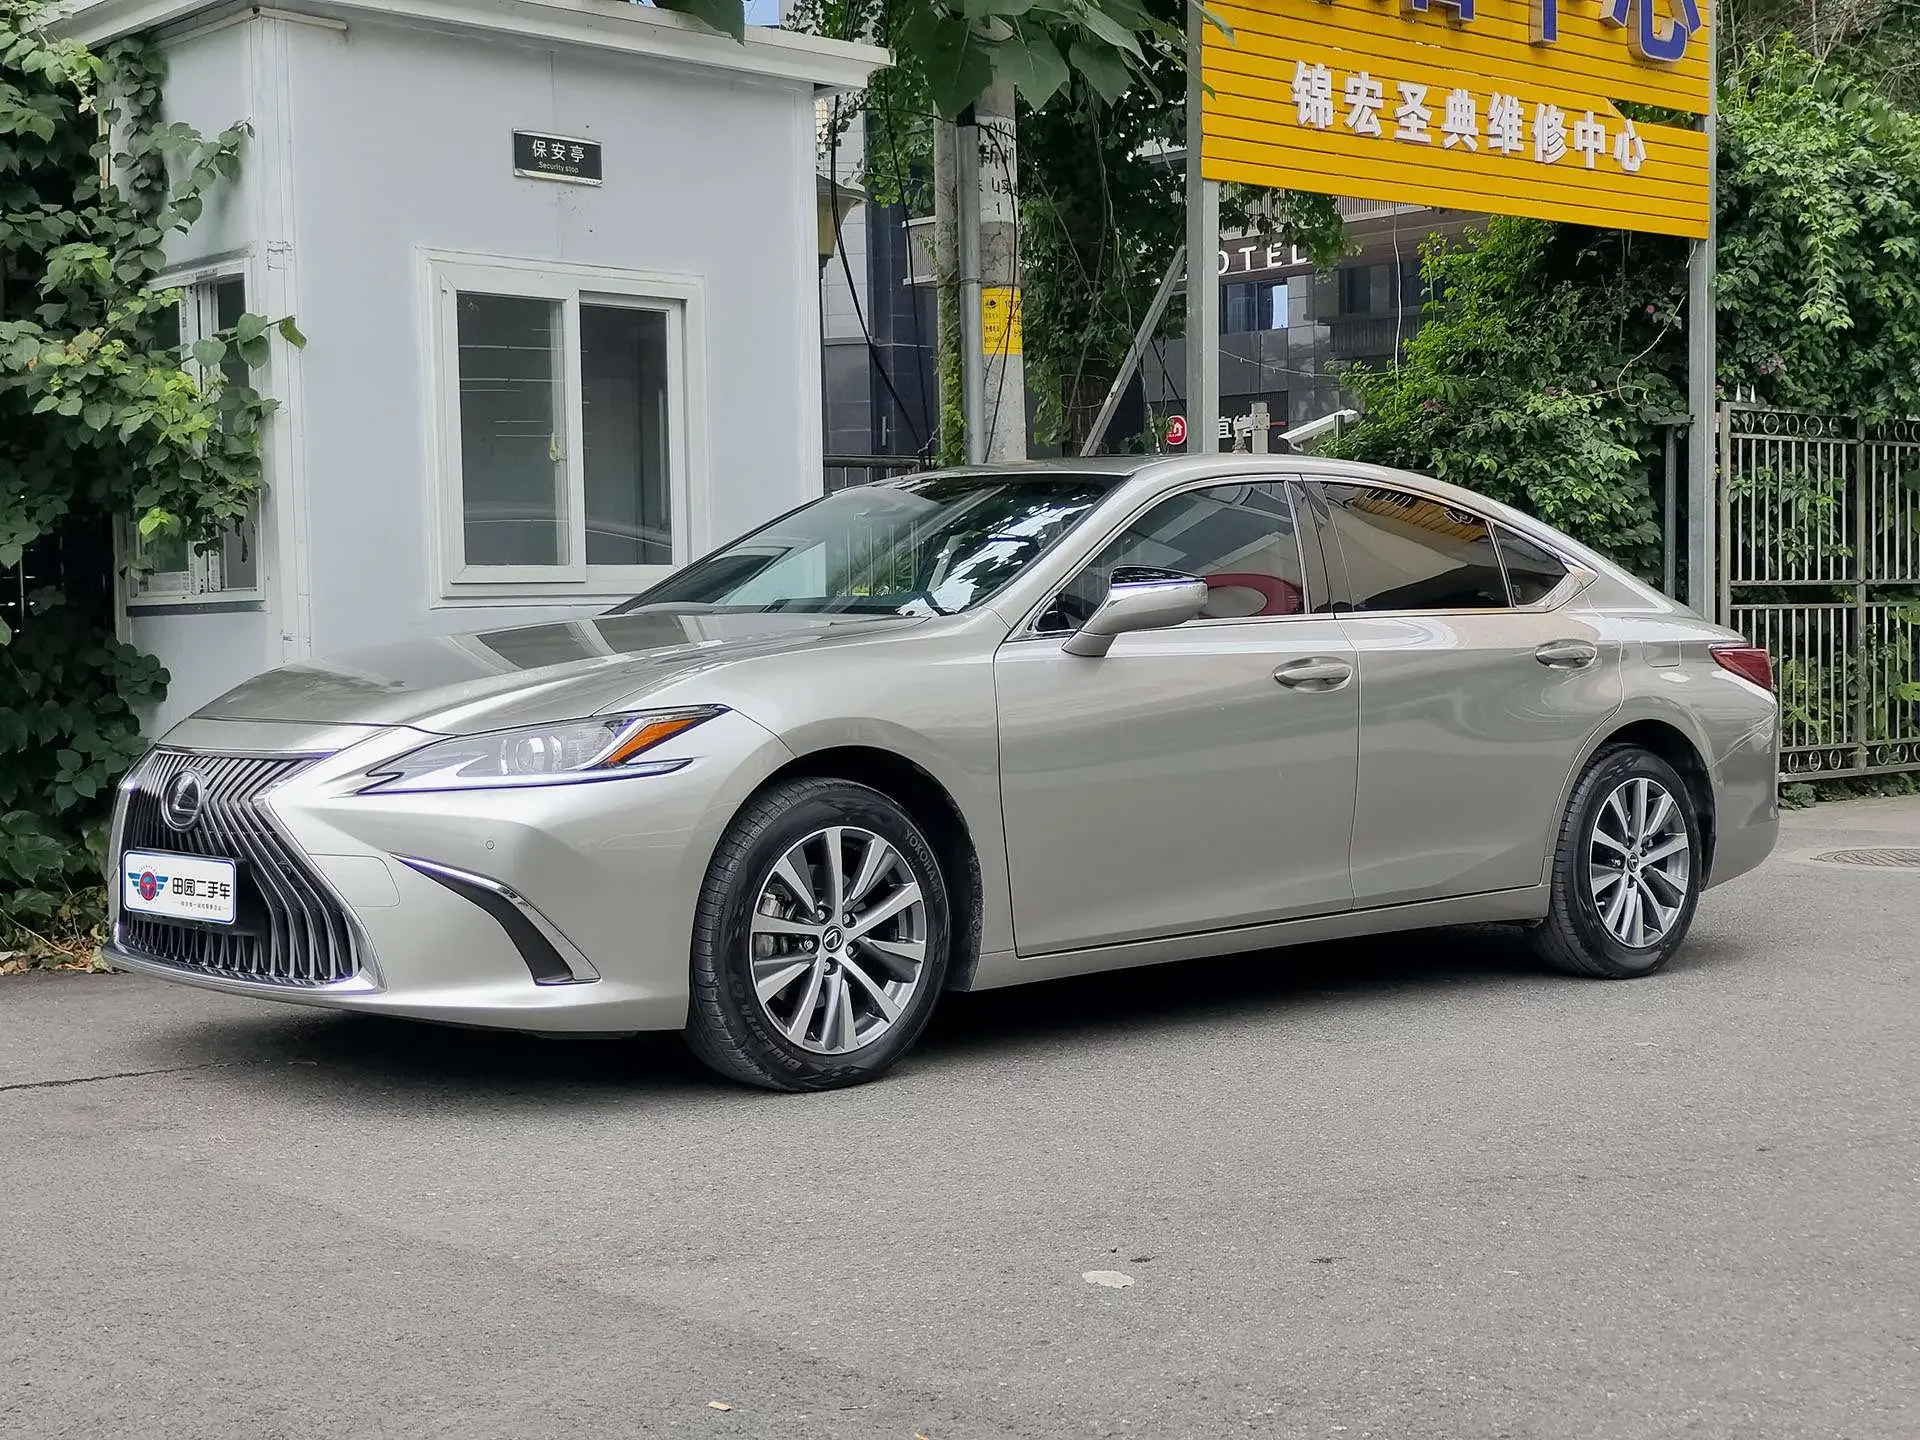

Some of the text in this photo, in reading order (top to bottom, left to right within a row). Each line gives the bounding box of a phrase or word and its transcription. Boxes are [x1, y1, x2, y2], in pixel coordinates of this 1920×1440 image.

[1290, 60, 1648, 173] 锦宏圣典维修中心
[532, 139, 585, 163] 保安亭
[538, 161, 579, 174] Security stop
[1218, 242, 1308, 275] OTEL
[172, 877, 231, 900] 田园二手车
